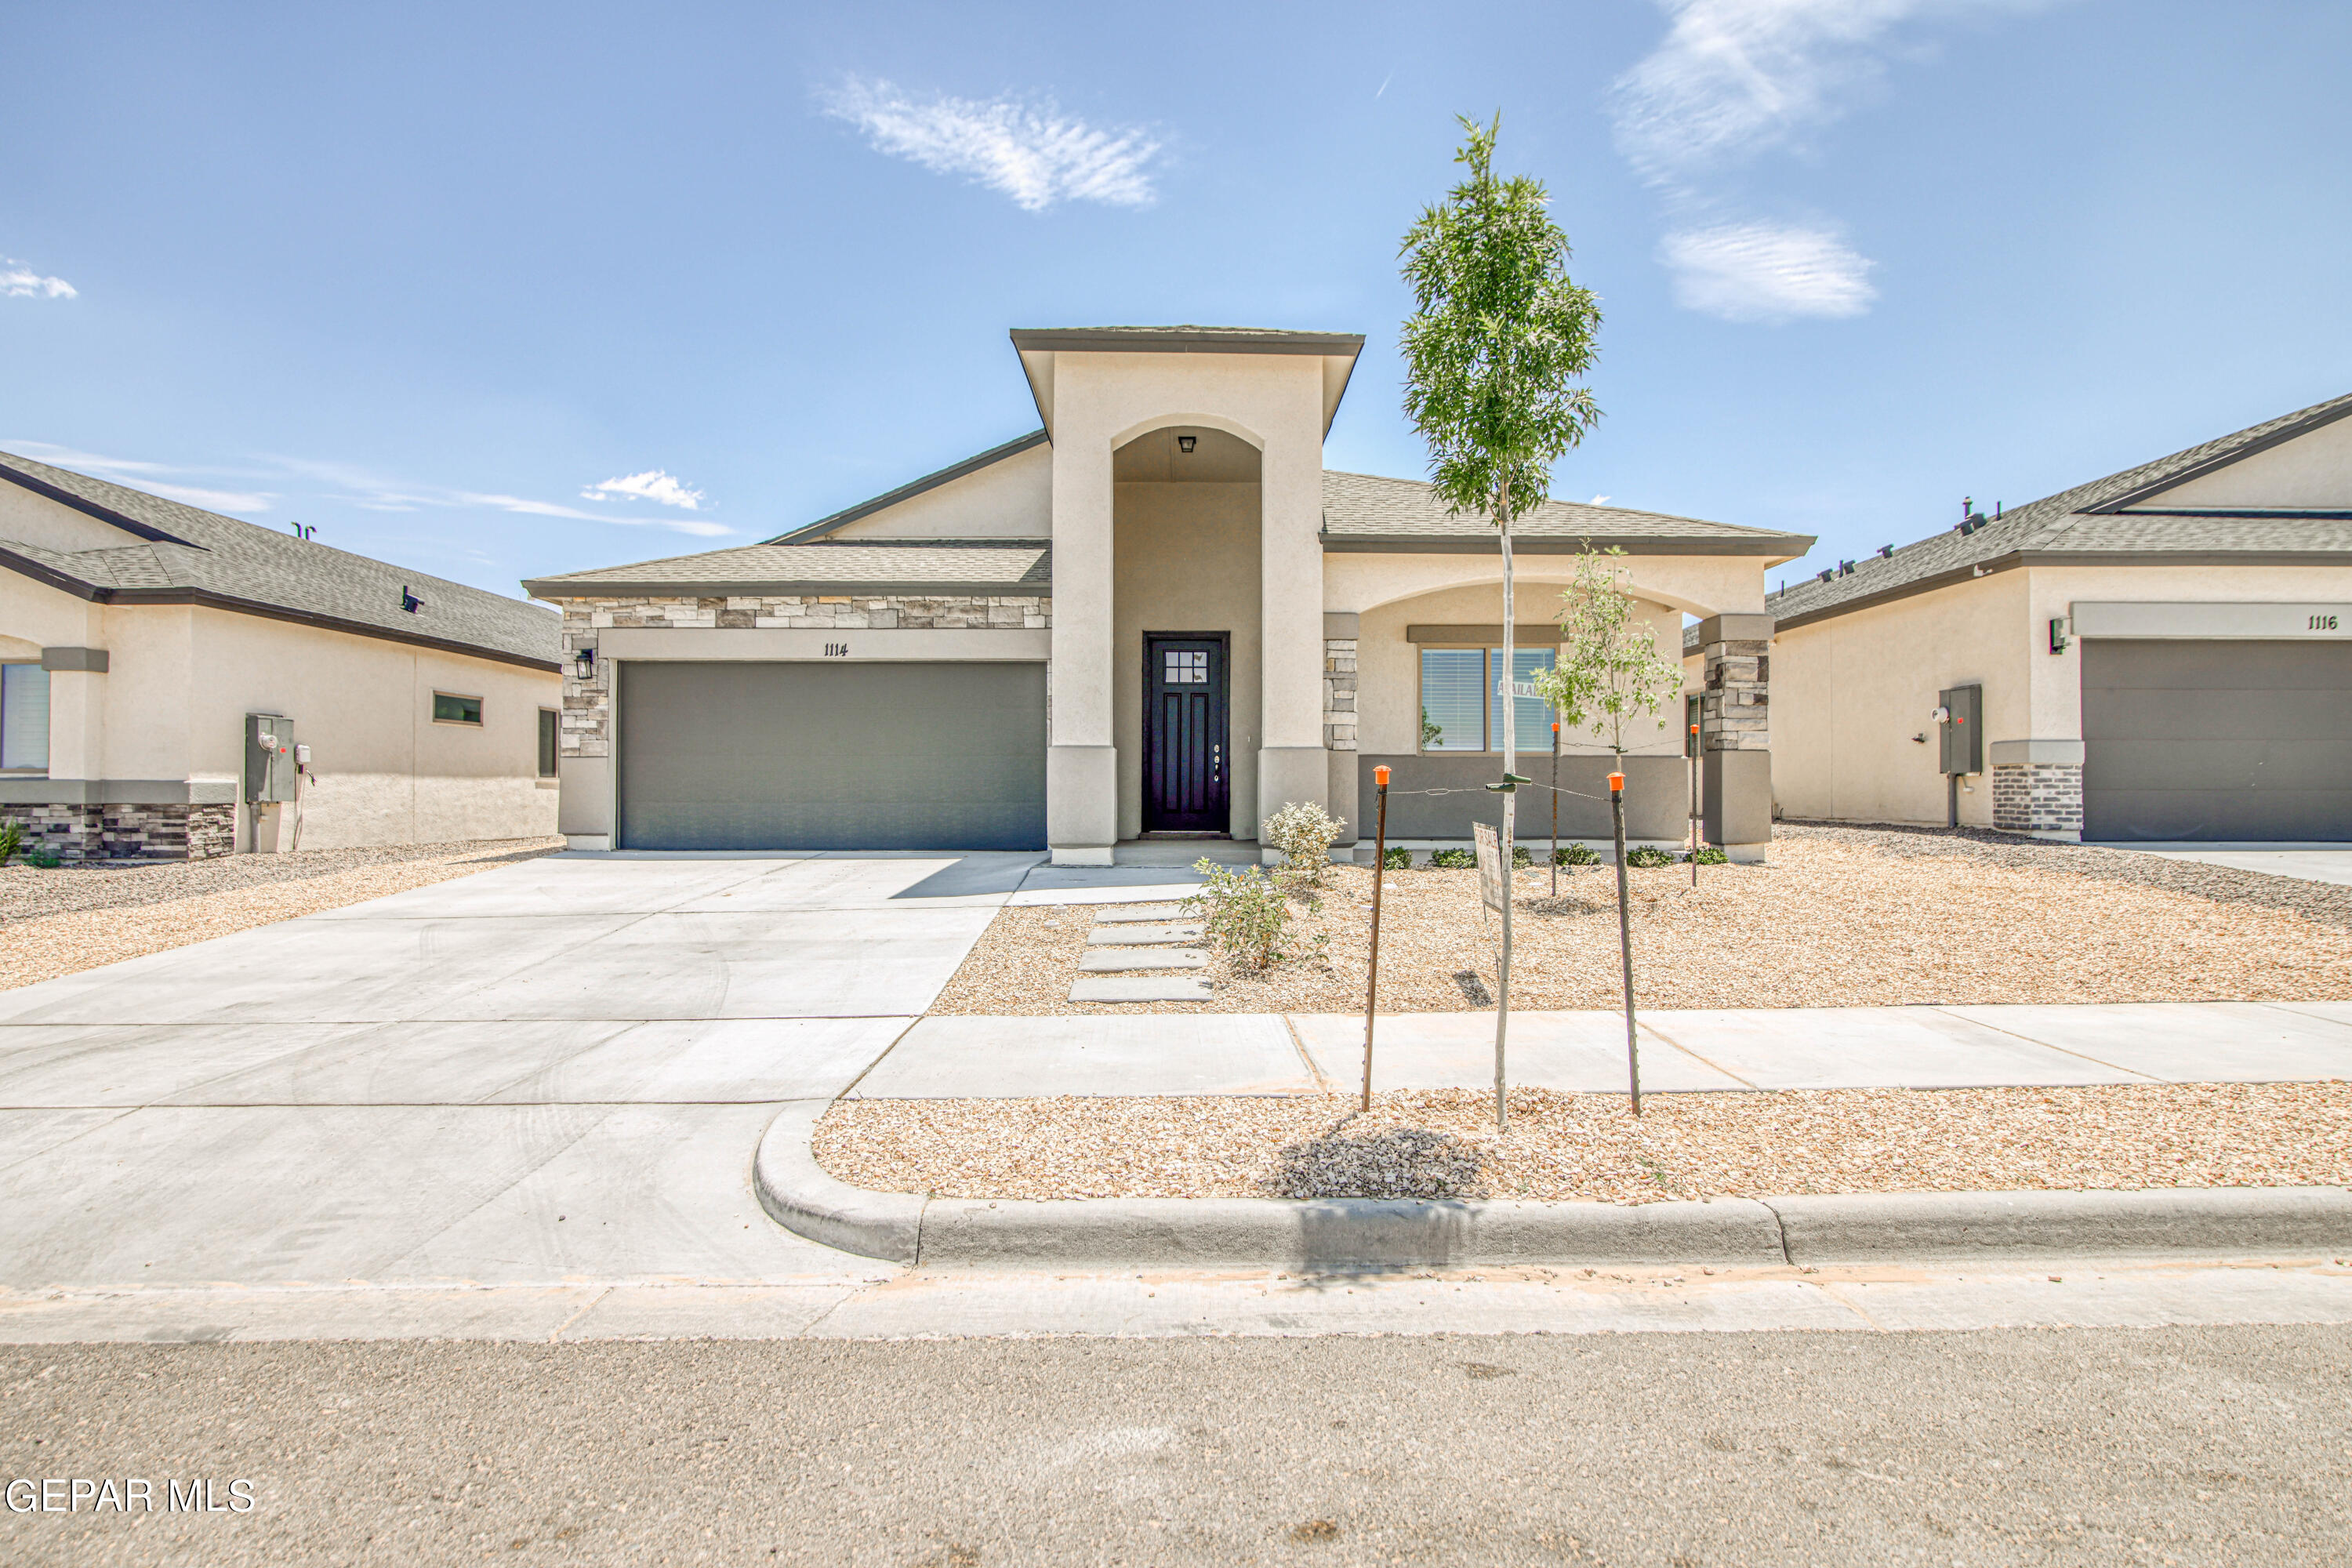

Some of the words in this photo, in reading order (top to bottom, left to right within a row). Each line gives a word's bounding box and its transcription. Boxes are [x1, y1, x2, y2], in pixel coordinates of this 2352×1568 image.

[2309, 615, 2338, 630] 1116
[825, 643, 848, 657] 1114
[1484, 830, 1498, 849] SALE
